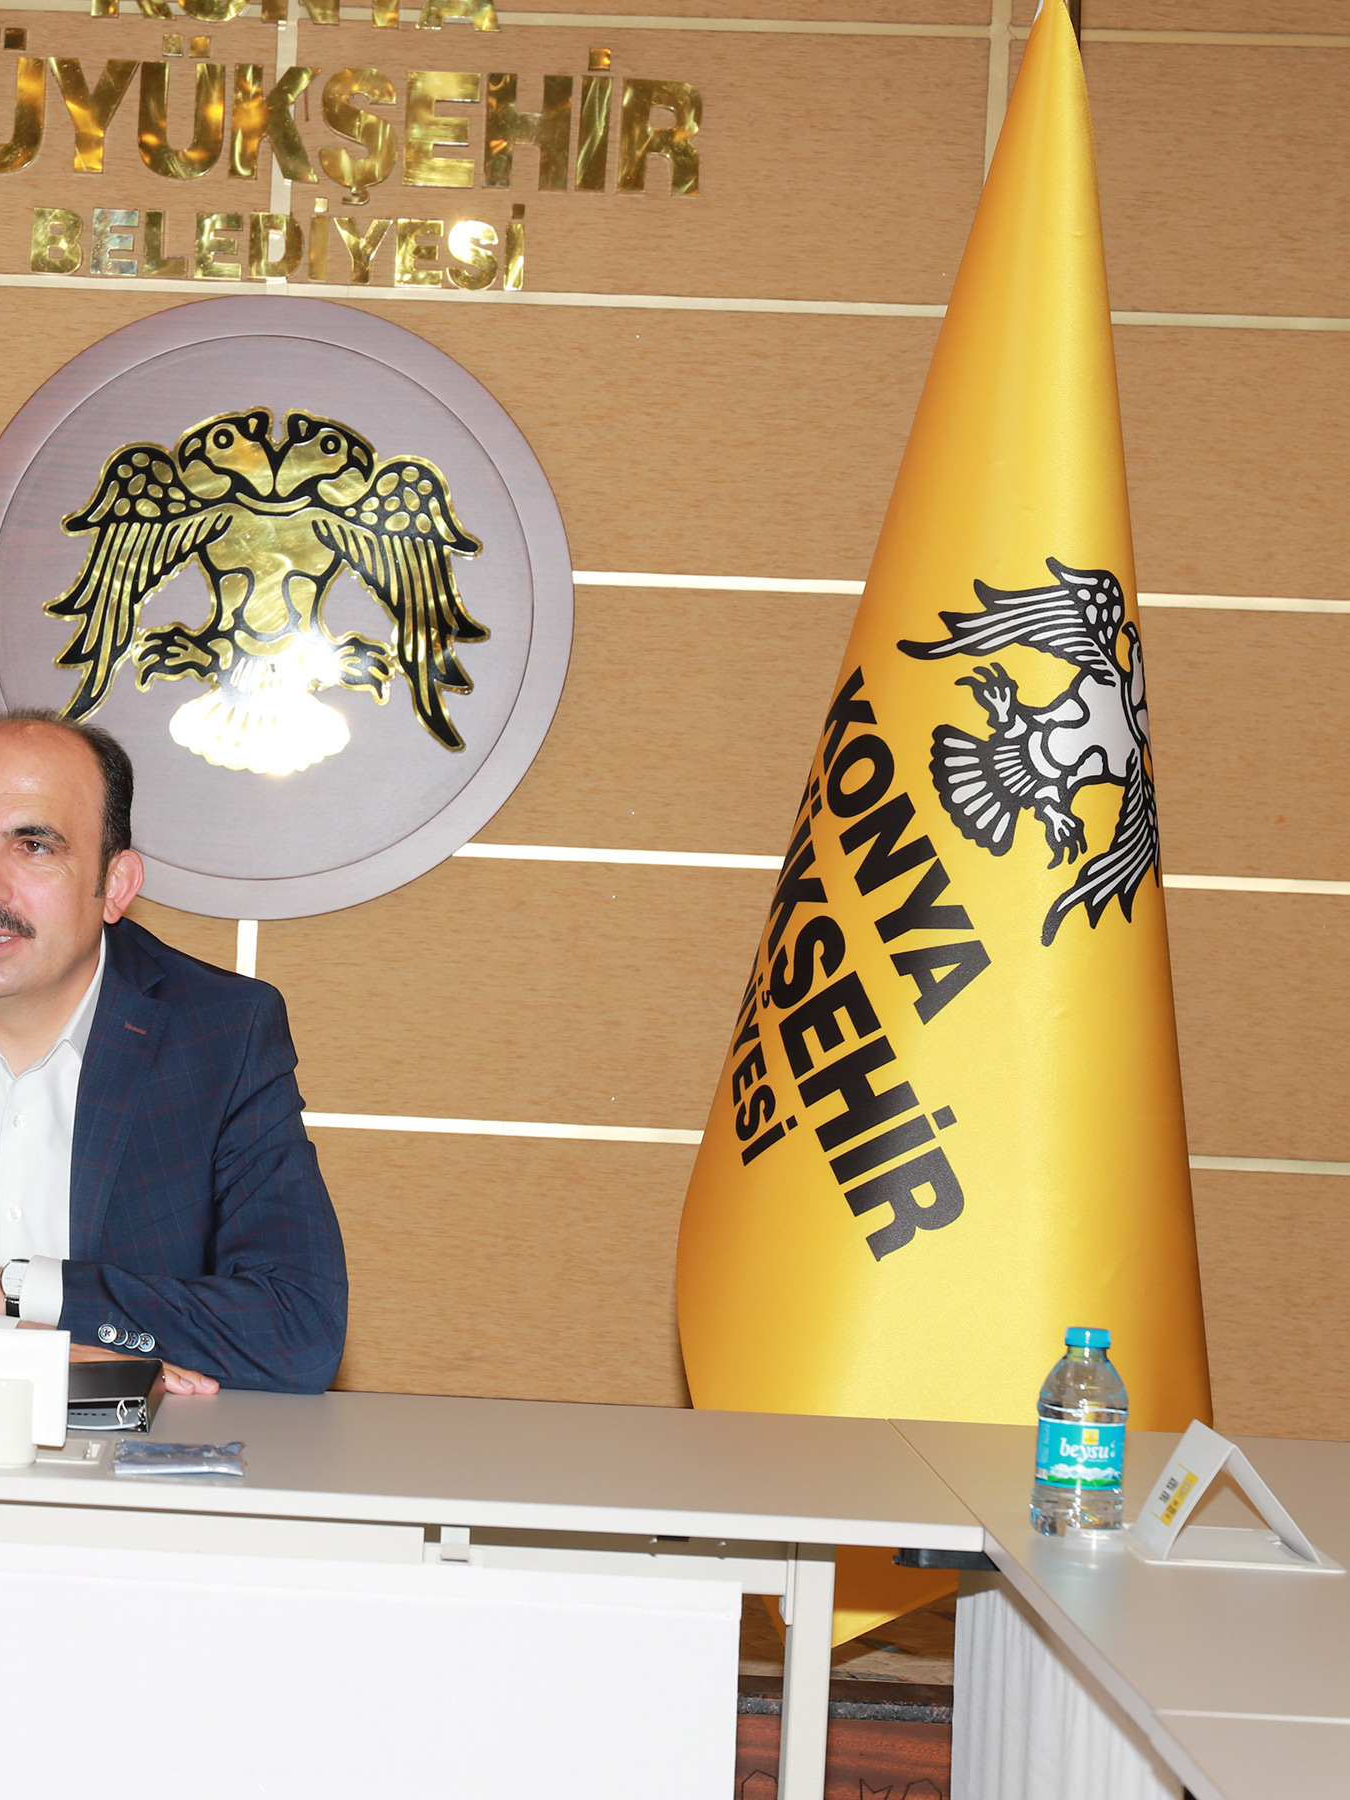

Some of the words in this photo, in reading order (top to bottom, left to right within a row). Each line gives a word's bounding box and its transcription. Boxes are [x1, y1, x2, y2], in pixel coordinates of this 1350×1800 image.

[30, 197, 526, 291] BELEDİYESİ
[823, 667, 992, 1025] KONYA
[762, 773, 965, 1262] ÜKŞEHİR
[1059, 1437, 1110, 1463] beysu
